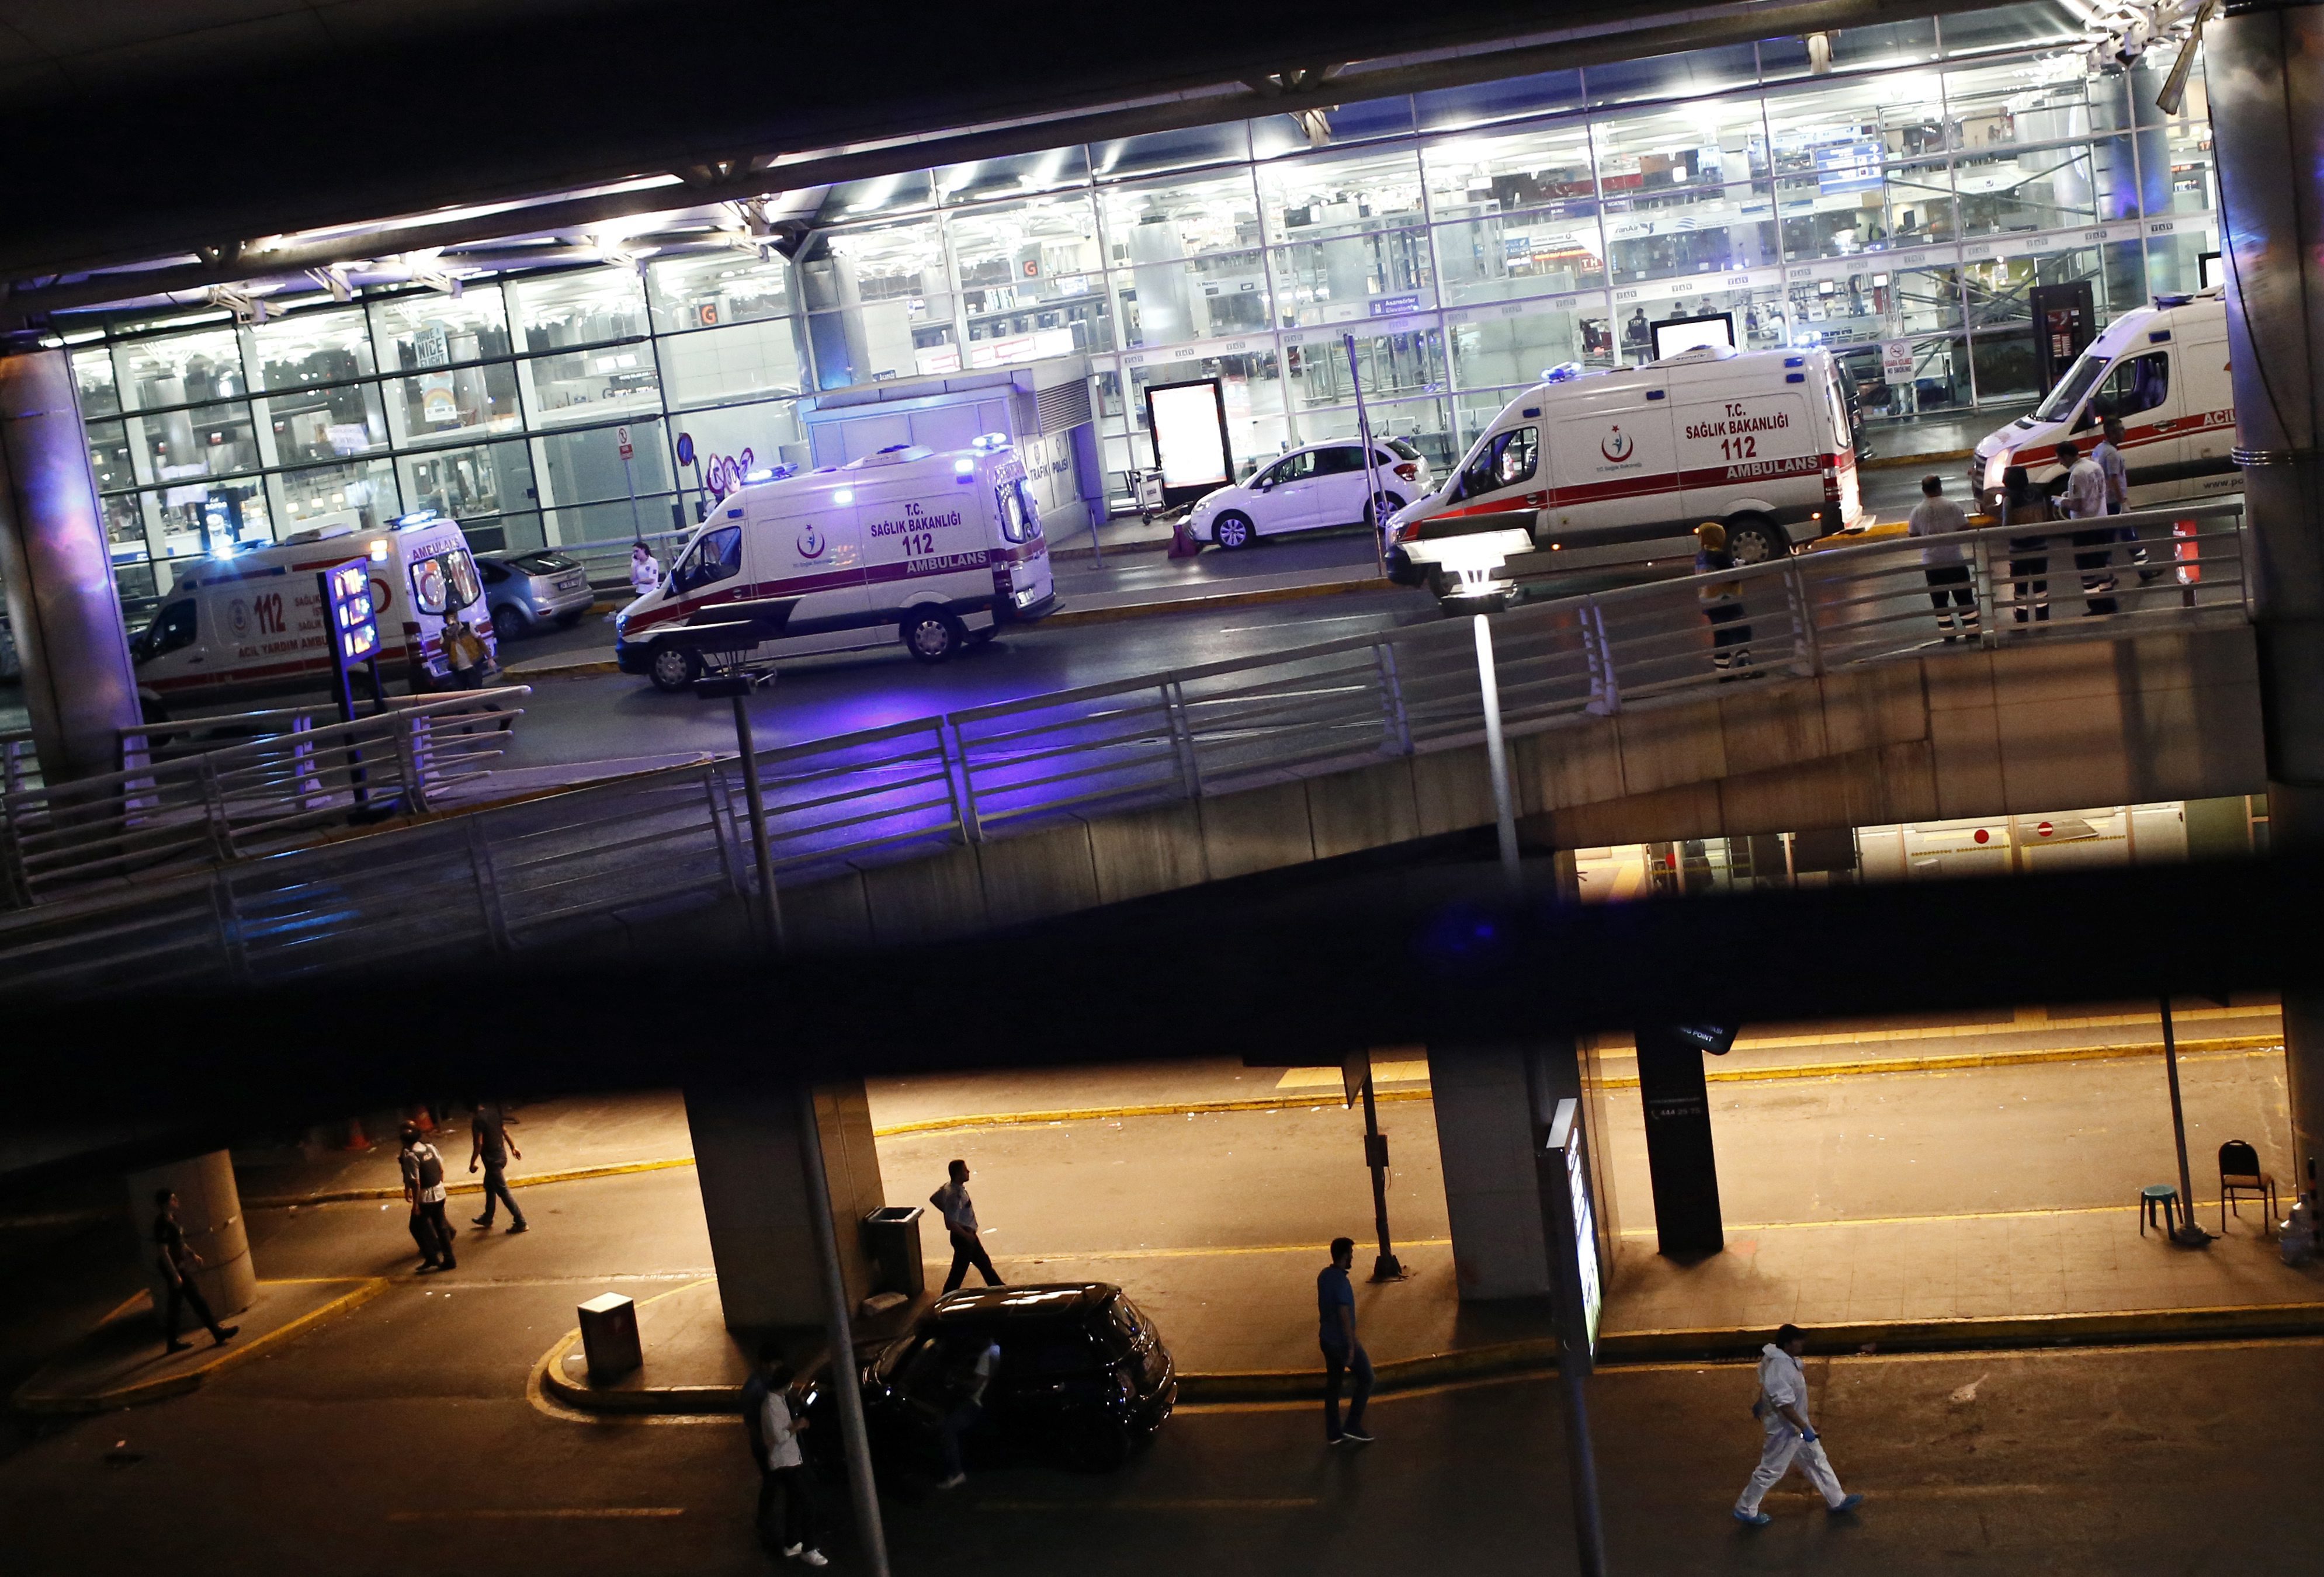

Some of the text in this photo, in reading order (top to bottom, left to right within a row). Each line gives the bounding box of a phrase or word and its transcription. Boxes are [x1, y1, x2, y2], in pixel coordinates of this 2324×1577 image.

[2151, 223, 2173, 232] TAV
[2085, 230, 2107, 241] TAV
[1026, 262, 1036, 275] G
[1671, 283, 1692, 292] TAV
[1728, 276, 1749, 285] TAV
[1617, 290, 1637, 300] TAV
[702, 304, 716, 324] G
[416, 328, 433, 343] HAVE
[417, 338, 443, 360] NICE
[1175, 349, 1195, 357] TAV
[1226, 342, 1246, 350] TAV
[420, 353, 445, 369] FLIGHT
[1125, 355, 1144, 364] TAV
[1725, 403, 1746, 417] T.C.
[1685, 412, 1789, 439] SAĞLIK BAKANLIĞI
[1721, 436, 1757, 460] 112
[1726, 456, 1818, 479] AMBULANS
[726, 466, 737, 486] 30
[905, 503, 924, 516] T.C.
[871, 511, 961, 537] SAĞLIK BAKANLIĞI
[412, 538, 460, 561] AMBULANS
[902, 533, 934, 556] 112
[906, 552, 987, 573] AMBULANS
[254, 592, 286, 635] 112
[239, 647, 259, 658] ACİL
[1692, 1030, 1713, 1042] POINT
